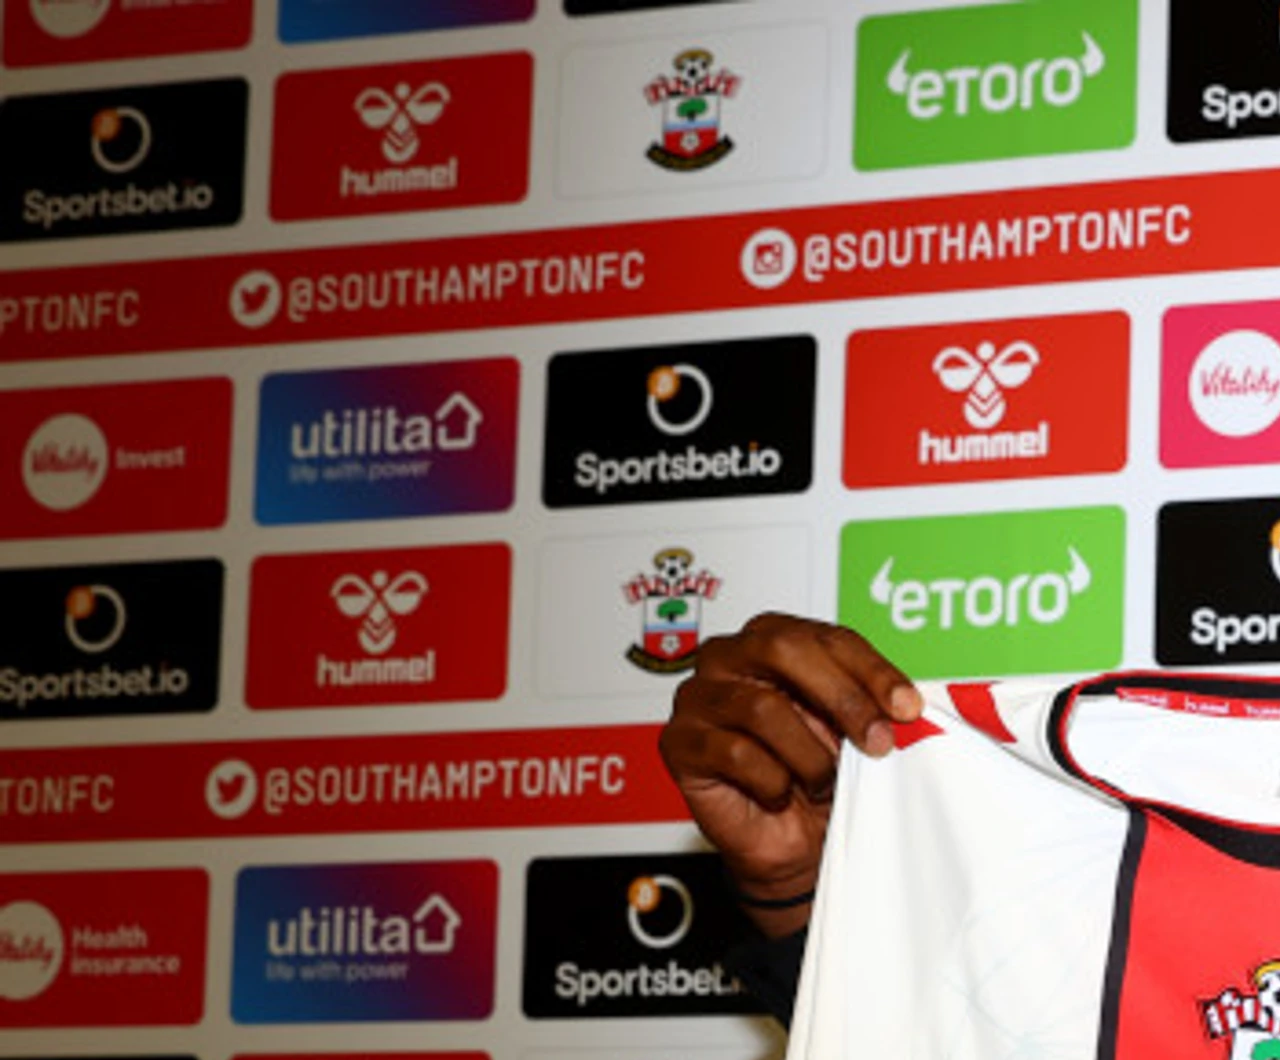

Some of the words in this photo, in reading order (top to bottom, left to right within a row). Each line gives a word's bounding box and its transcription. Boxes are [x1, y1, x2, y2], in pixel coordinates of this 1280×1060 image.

[341, 156, 457, 195] hummel
[24, 181, 213, 230] Sportsbet.io
[804, 205, 1191, 282] @SOUTHAMPTONFC
[288, 252, 646, 322] @SOUTHAMPTONFC
[292, 408, 432, 458] utilita
[919, 420, 1049, 463] hummel
[576, 441, 781, 492] Sportsbet.io
[318, 648, 435, 685] hummel
[266, 755, 625, 813] @SOUTHAMPTONFC
[72, 925, 147, 949] Health
[268, 907, 409, 956] utilita
